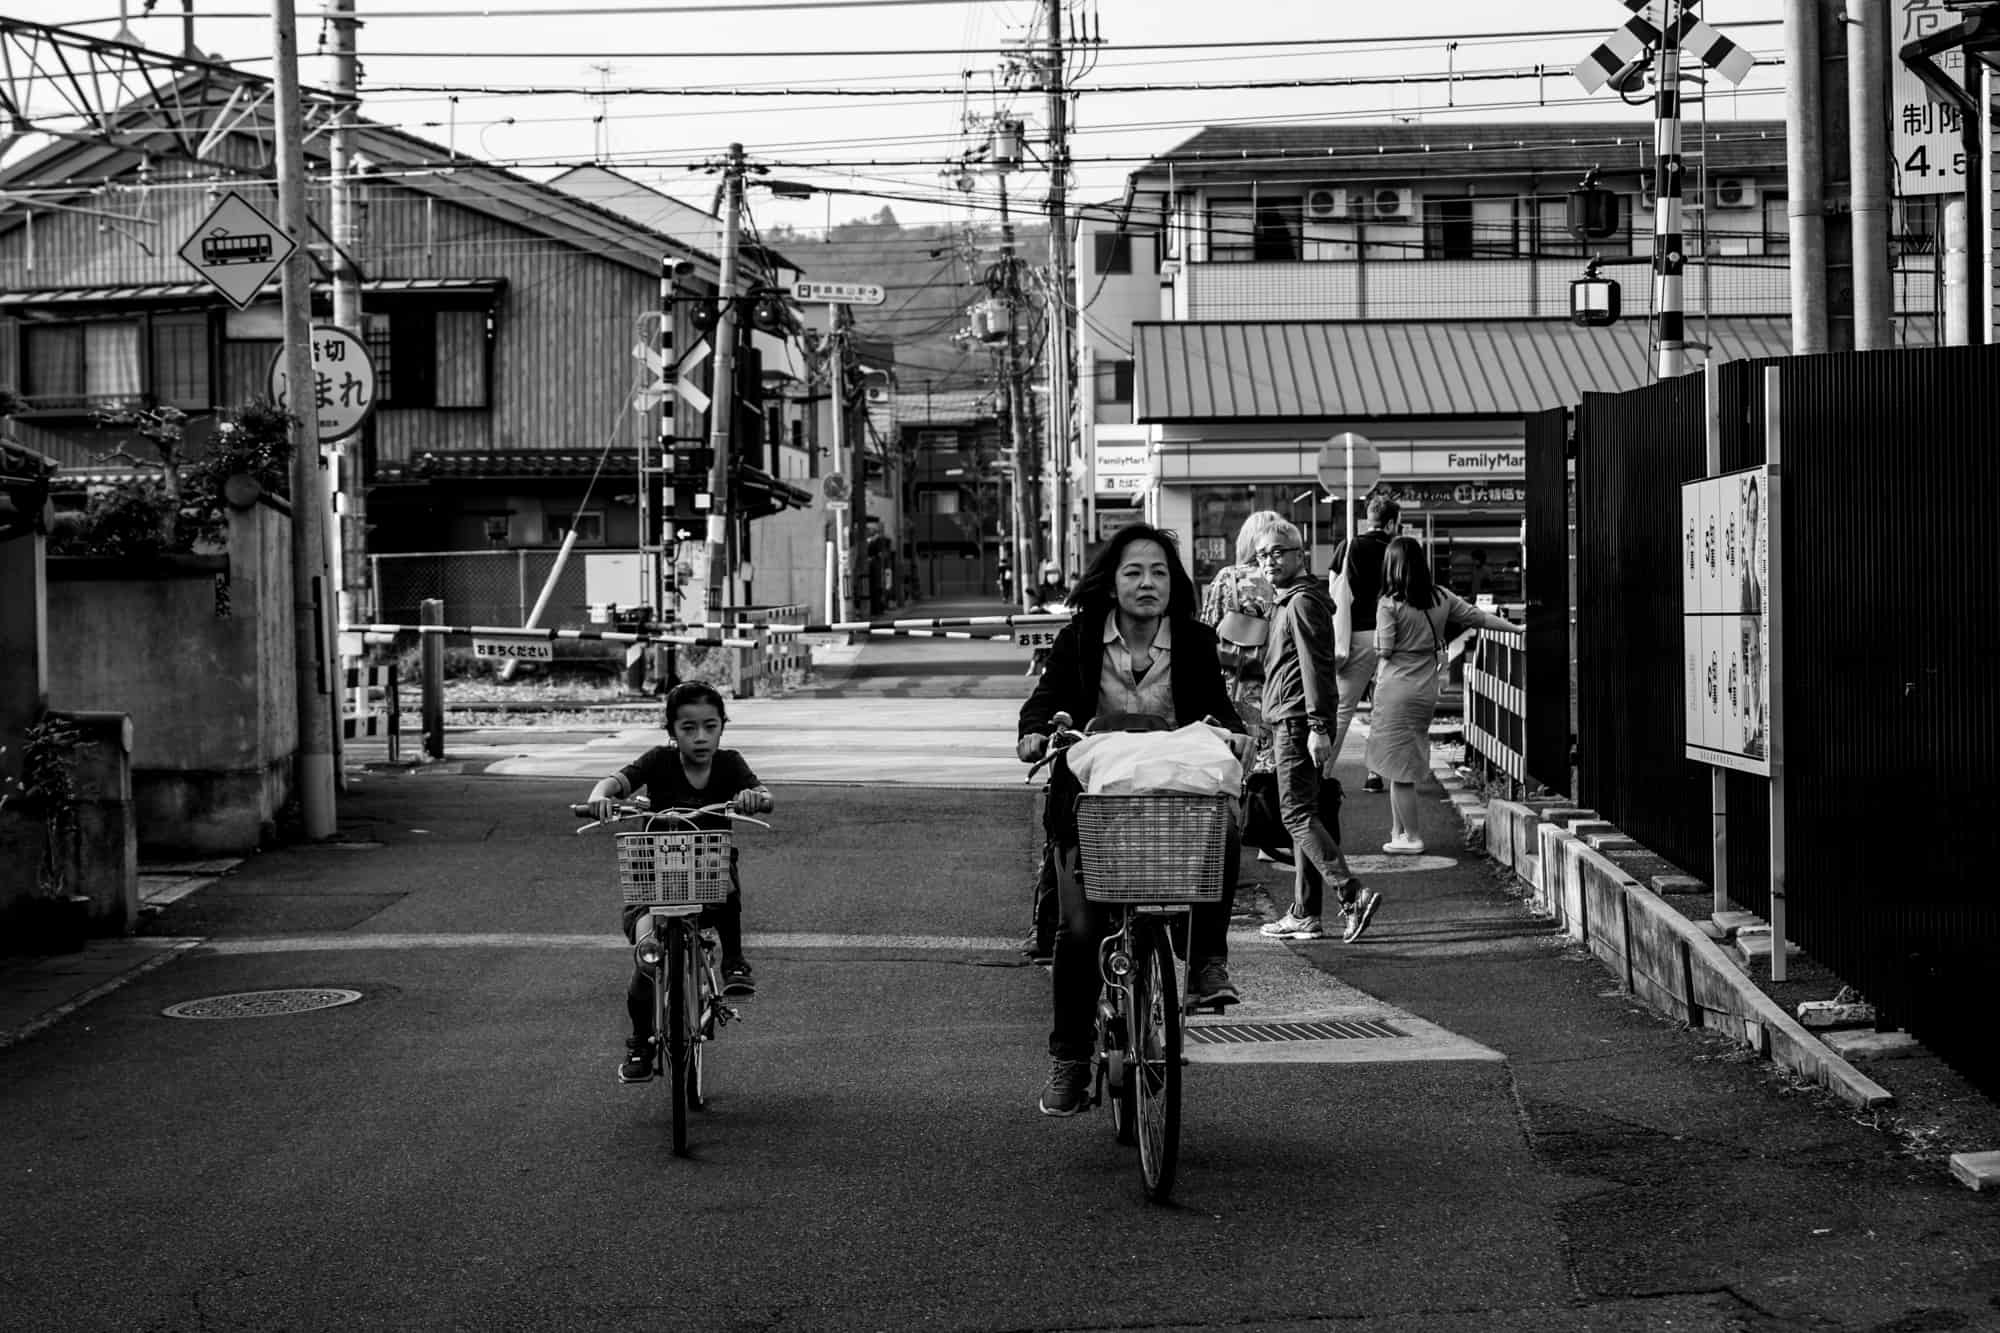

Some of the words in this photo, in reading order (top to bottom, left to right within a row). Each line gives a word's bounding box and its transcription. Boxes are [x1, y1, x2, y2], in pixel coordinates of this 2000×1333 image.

[1098, 456, 1144, 466] FamilyMart
[477, 644, 549, 657] おまちください
